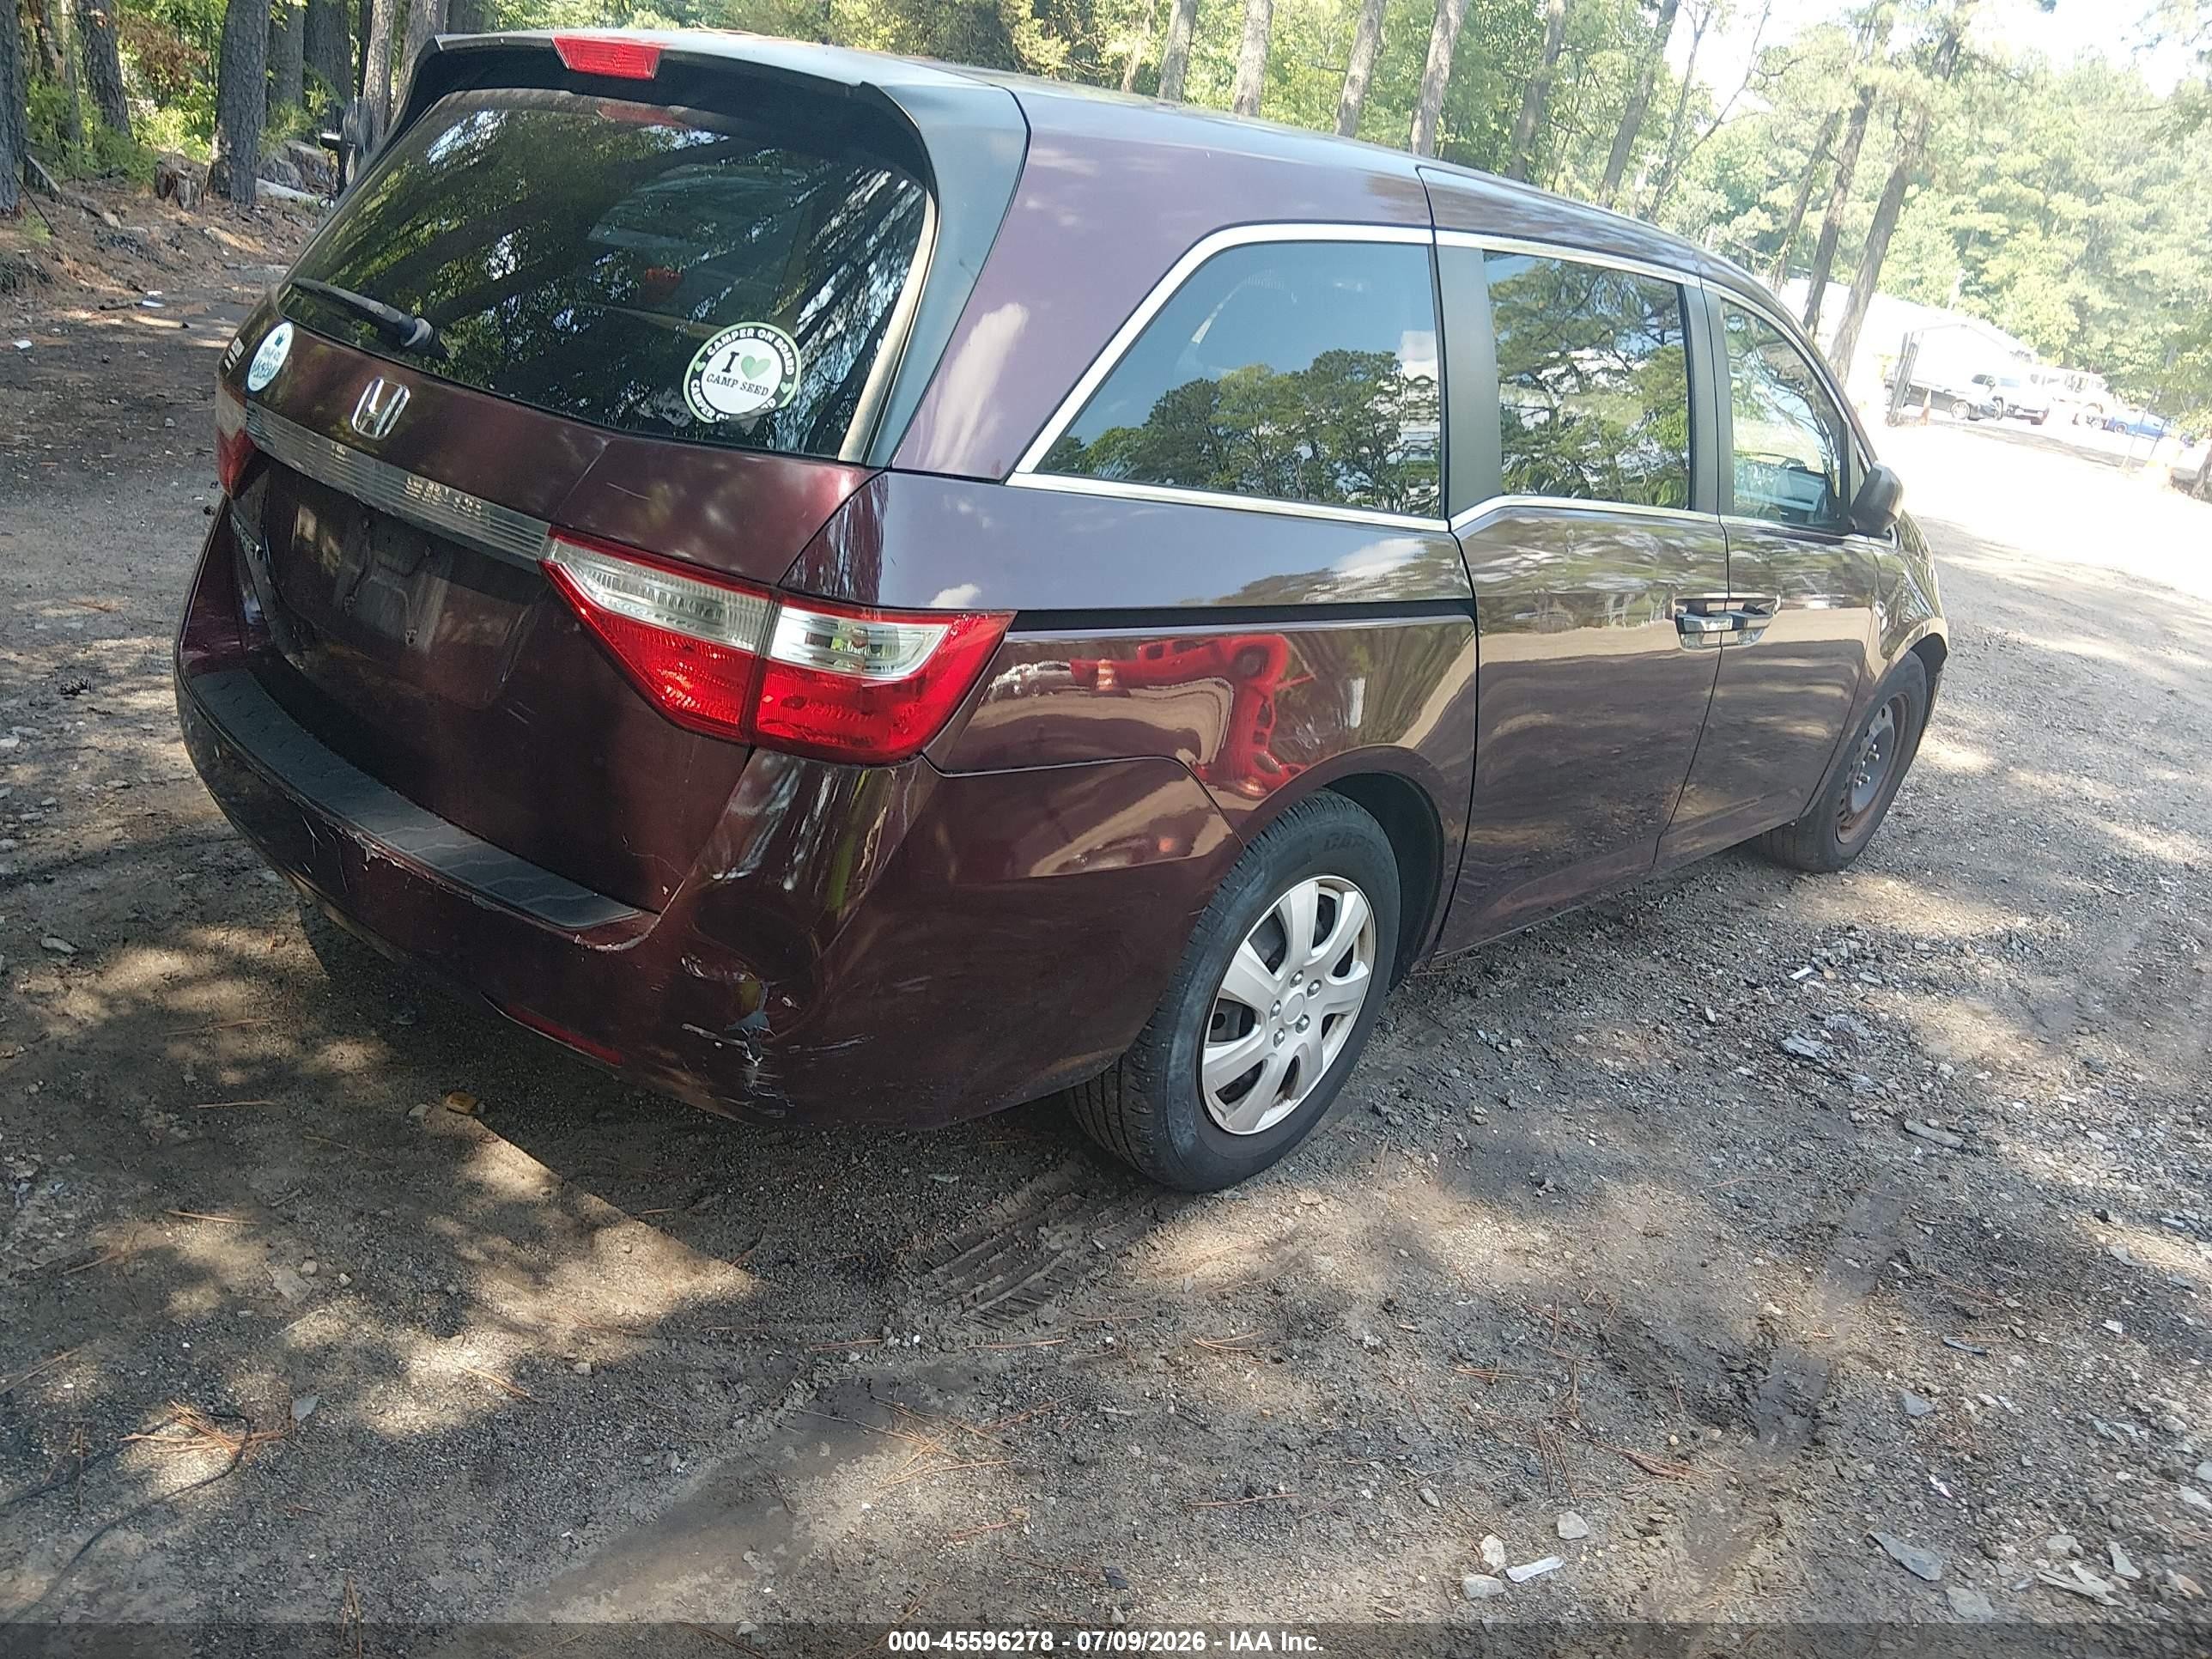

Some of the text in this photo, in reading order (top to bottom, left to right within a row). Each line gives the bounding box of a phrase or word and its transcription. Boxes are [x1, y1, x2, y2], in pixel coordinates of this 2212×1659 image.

[706, 327, 795, 376] CAMPER ON BOARD
[720, 350, 740, 374] I
[706, 373, 769, 398] CAMP SEED
